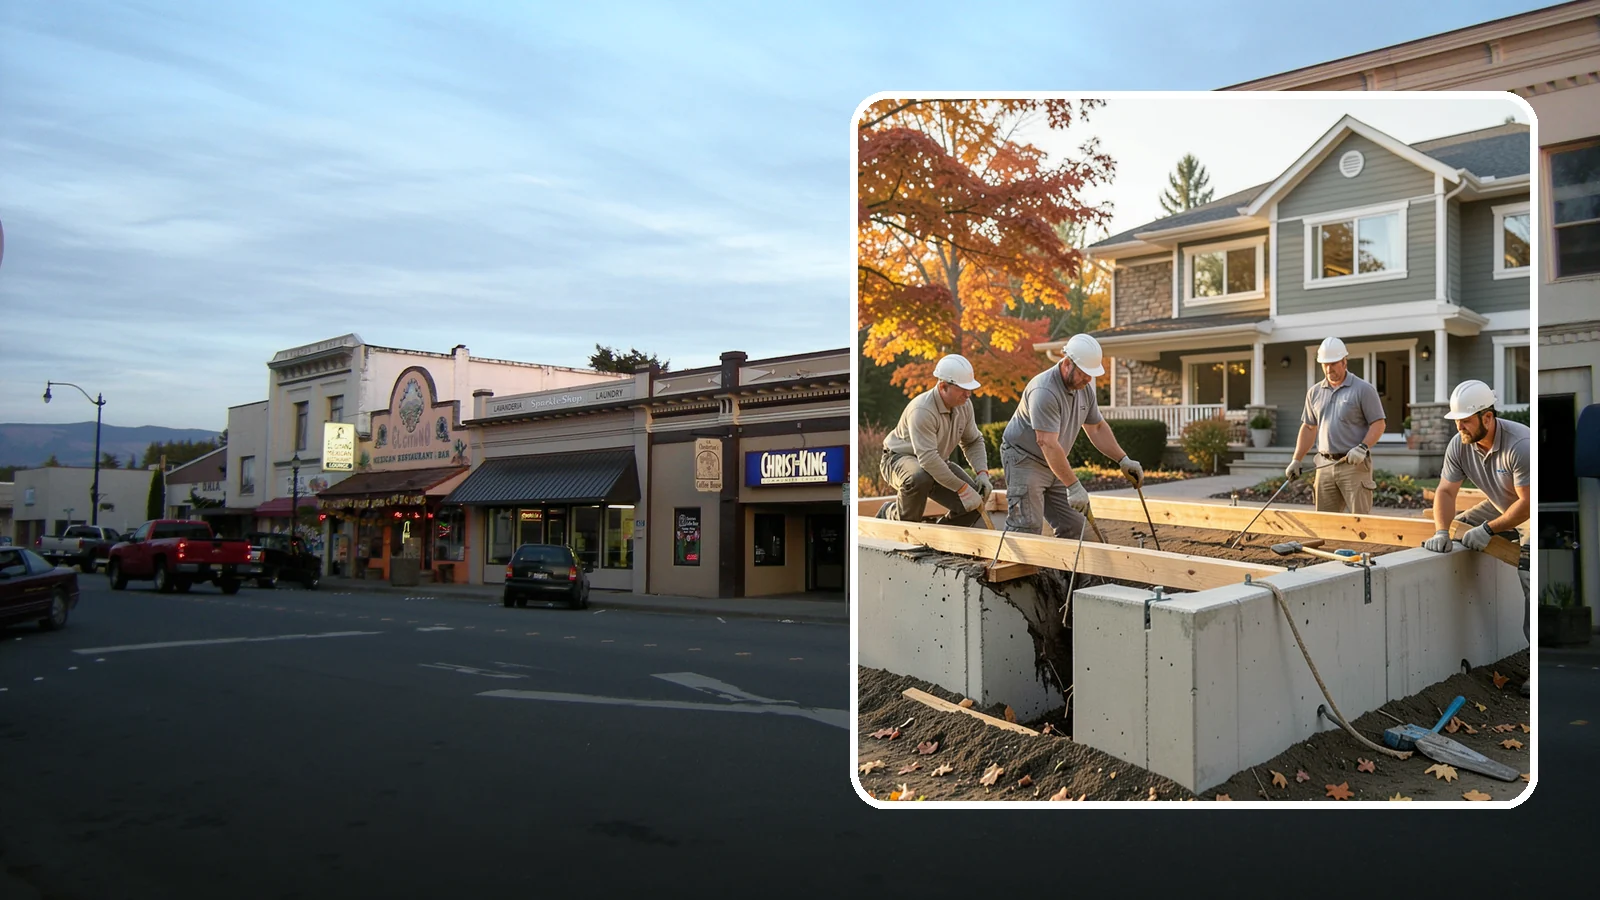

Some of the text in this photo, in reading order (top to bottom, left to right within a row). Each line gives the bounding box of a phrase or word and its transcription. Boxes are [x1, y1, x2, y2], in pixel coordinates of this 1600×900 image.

[493, 402, 523, 413] LAVANDERIA
[562, 394, 583, 404] Shop
[595, 388, 624, 400] LAUNDRY
[373, 450, 450, 464] MEXICAN RESTAURANT BAR
[761, 450, 827, 478] CHRIST KING
